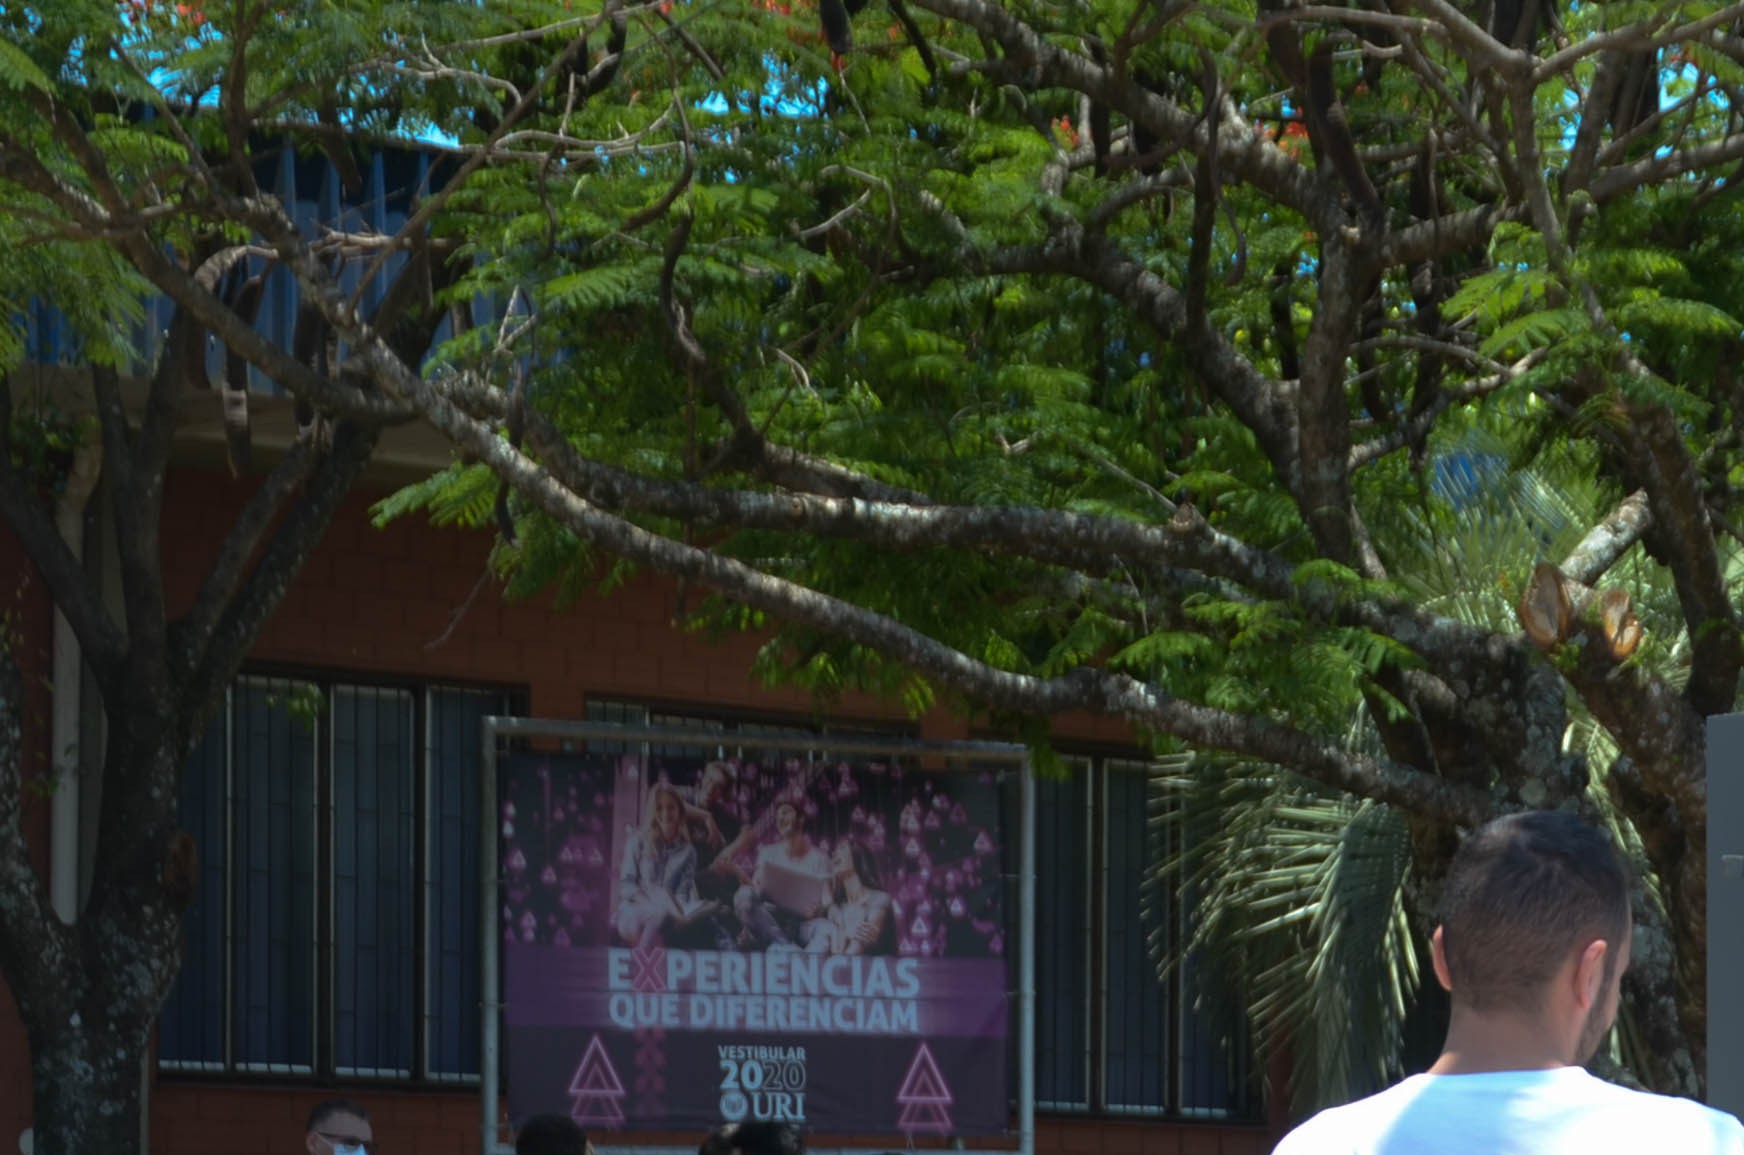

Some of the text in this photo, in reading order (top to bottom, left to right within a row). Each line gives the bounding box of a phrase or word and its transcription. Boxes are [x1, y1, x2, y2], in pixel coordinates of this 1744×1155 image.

[608, 992, 920, 1034] QUE DIFERENCIAM
[717, 1044, 806, 1061] VESTIBULAR
[719, 1059, 806, 1090] 2020
[751, 1091, 806, 1120] URI
